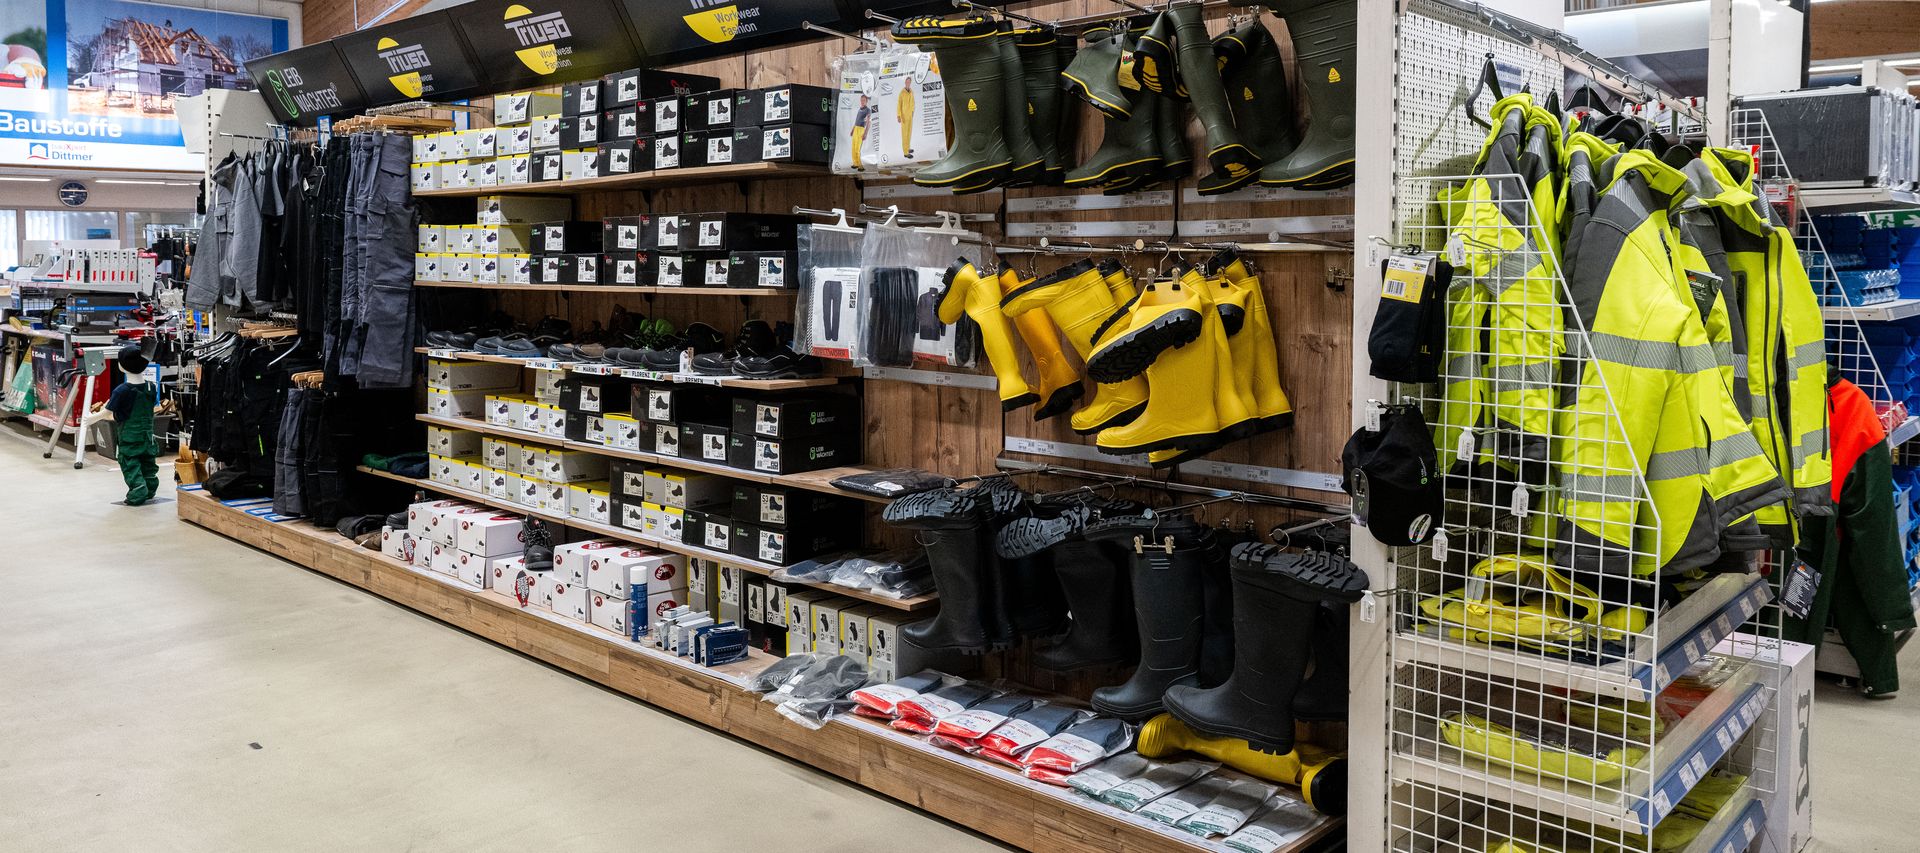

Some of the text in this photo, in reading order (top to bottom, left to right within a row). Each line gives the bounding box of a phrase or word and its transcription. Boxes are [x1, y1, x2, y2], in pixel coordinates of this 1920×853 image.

[714, 6, 760, 24] Workwear
[720, 22, 758, 37] Fashion
[538, 46, 573, 59] Workwear
[544, 58, 573, 70] Fashion
[280, 66, 304, 88] LEIB
[407, 74, 433, 86] Workwear
[412, 84, 434, 94] Fashion
[0, 111, 122, 138] Baustoffe
[51, 150, 94, 161] Dittmer
[660, 257, 667, 265] S3
[762, 495, 768, 503] S3
[768, 611, 773, 622] S3
